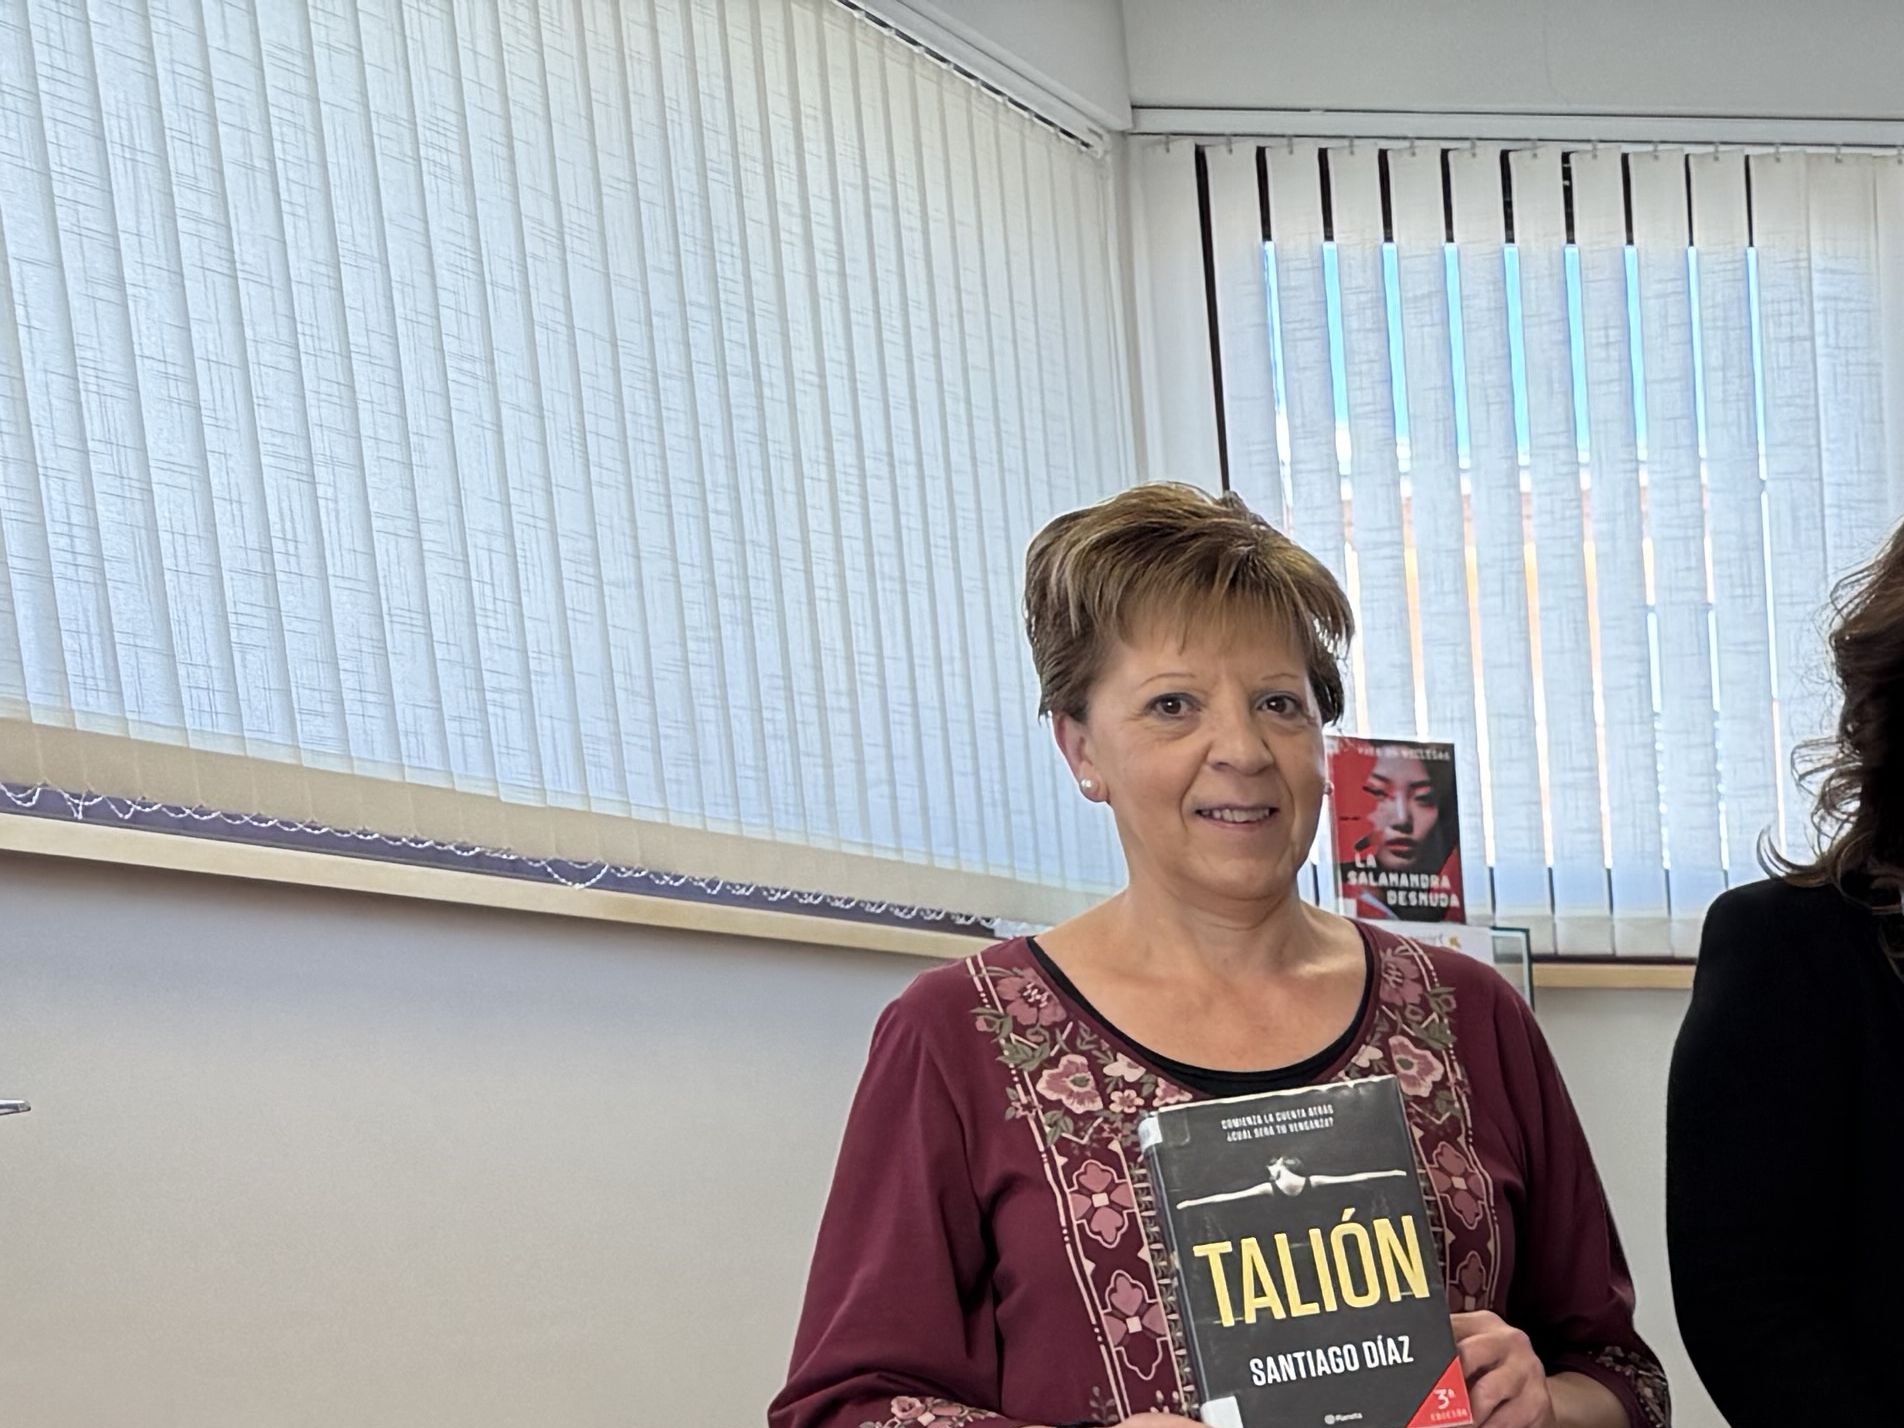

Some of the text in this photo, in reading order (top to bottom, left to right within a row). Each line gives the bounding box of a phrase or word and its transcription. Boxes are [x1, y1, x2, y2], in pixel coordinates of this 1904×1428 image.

[1347, 871, 1451, 889] SALAMANDRA
[1387, 890, 1460, 908] DESNUDA
[1192, 1207, 1430, 1328] TALIÓN
[1249, 1335, 1415, 1387] SANTIAGO DÍAZ
